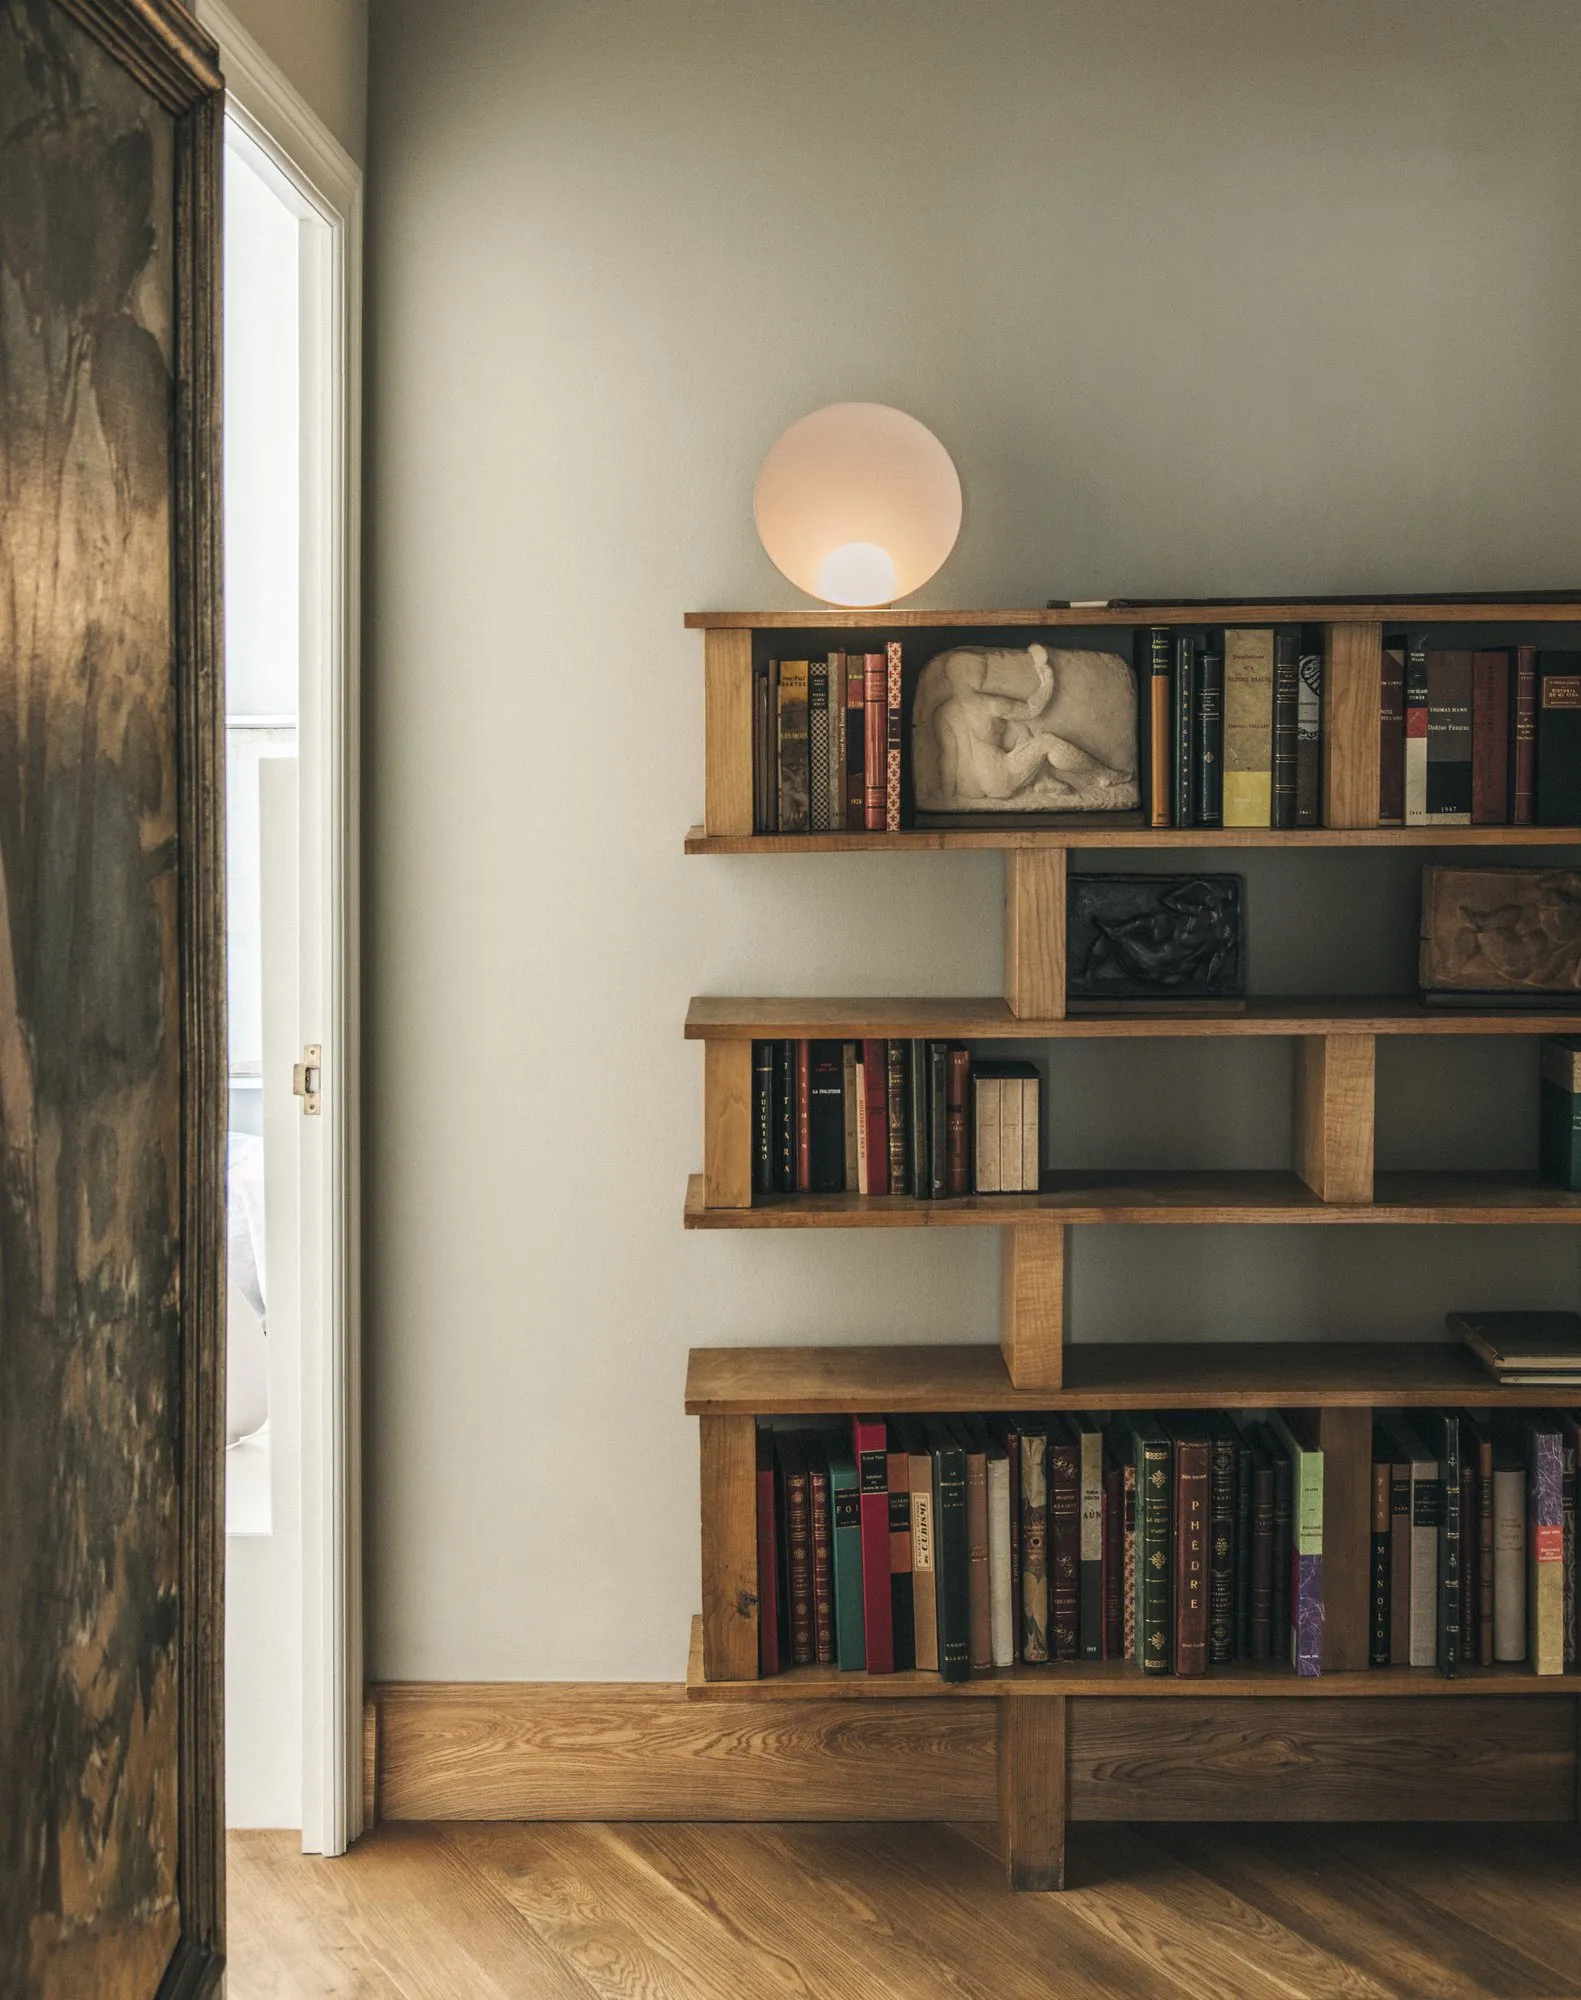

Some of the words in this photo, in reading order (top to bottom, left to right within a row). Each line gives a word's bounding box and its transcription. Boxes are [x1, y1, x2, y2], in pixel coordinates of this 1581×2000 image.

[760, 1091, 769, 1161] FUTURISMO
[920, 1502, 930, 1552] CUBISME
[1377, 1545, 1385, 1638] MANOLO
